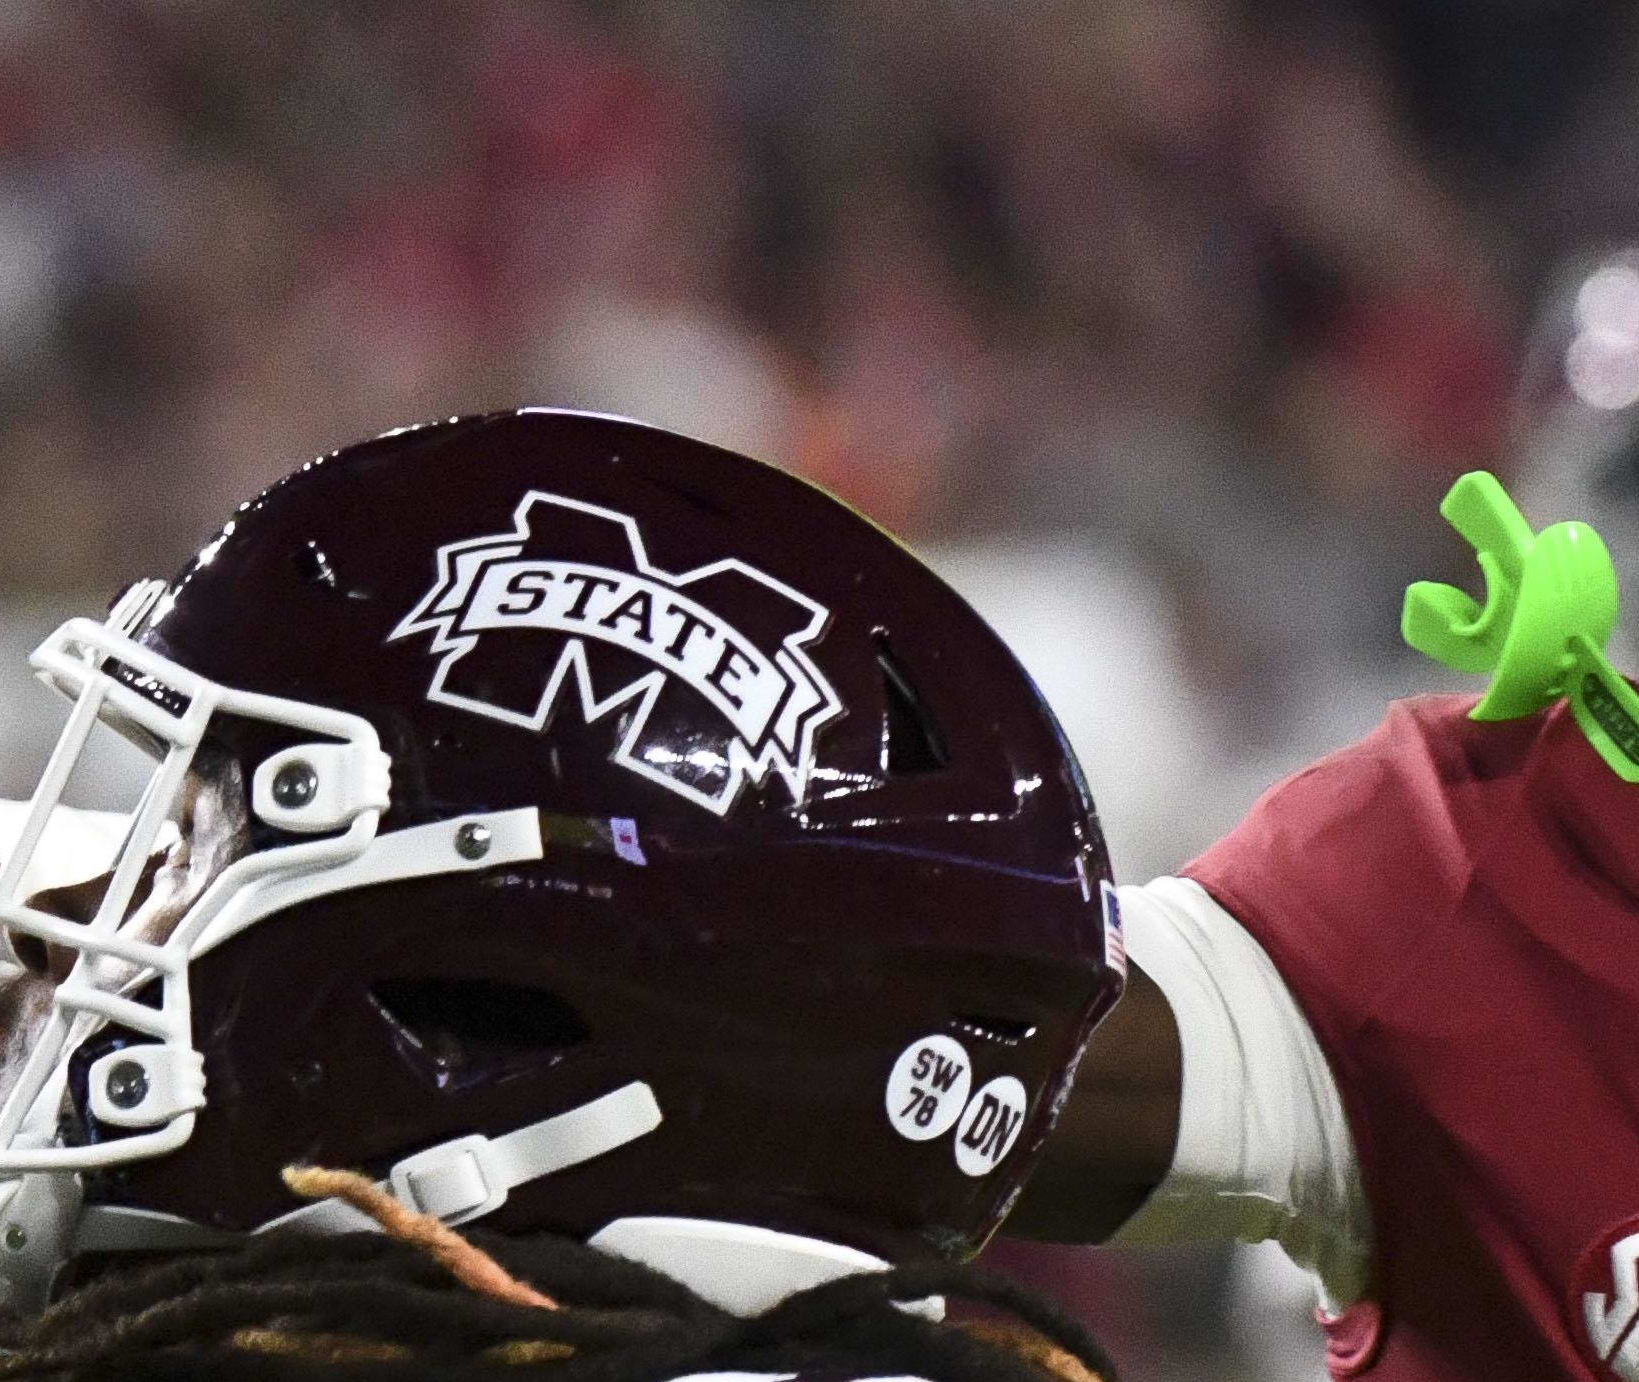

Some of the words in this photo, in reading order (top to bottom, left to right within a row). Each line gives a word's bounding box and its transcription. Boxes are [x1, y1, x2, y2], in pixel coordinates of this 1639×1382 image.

[496, 568, 768, 714] STATE
[912, 1048, 964, 1093] SW
[900, 1086, 939, 1127] 78
[962, 1093, 1022, 1162] DN
